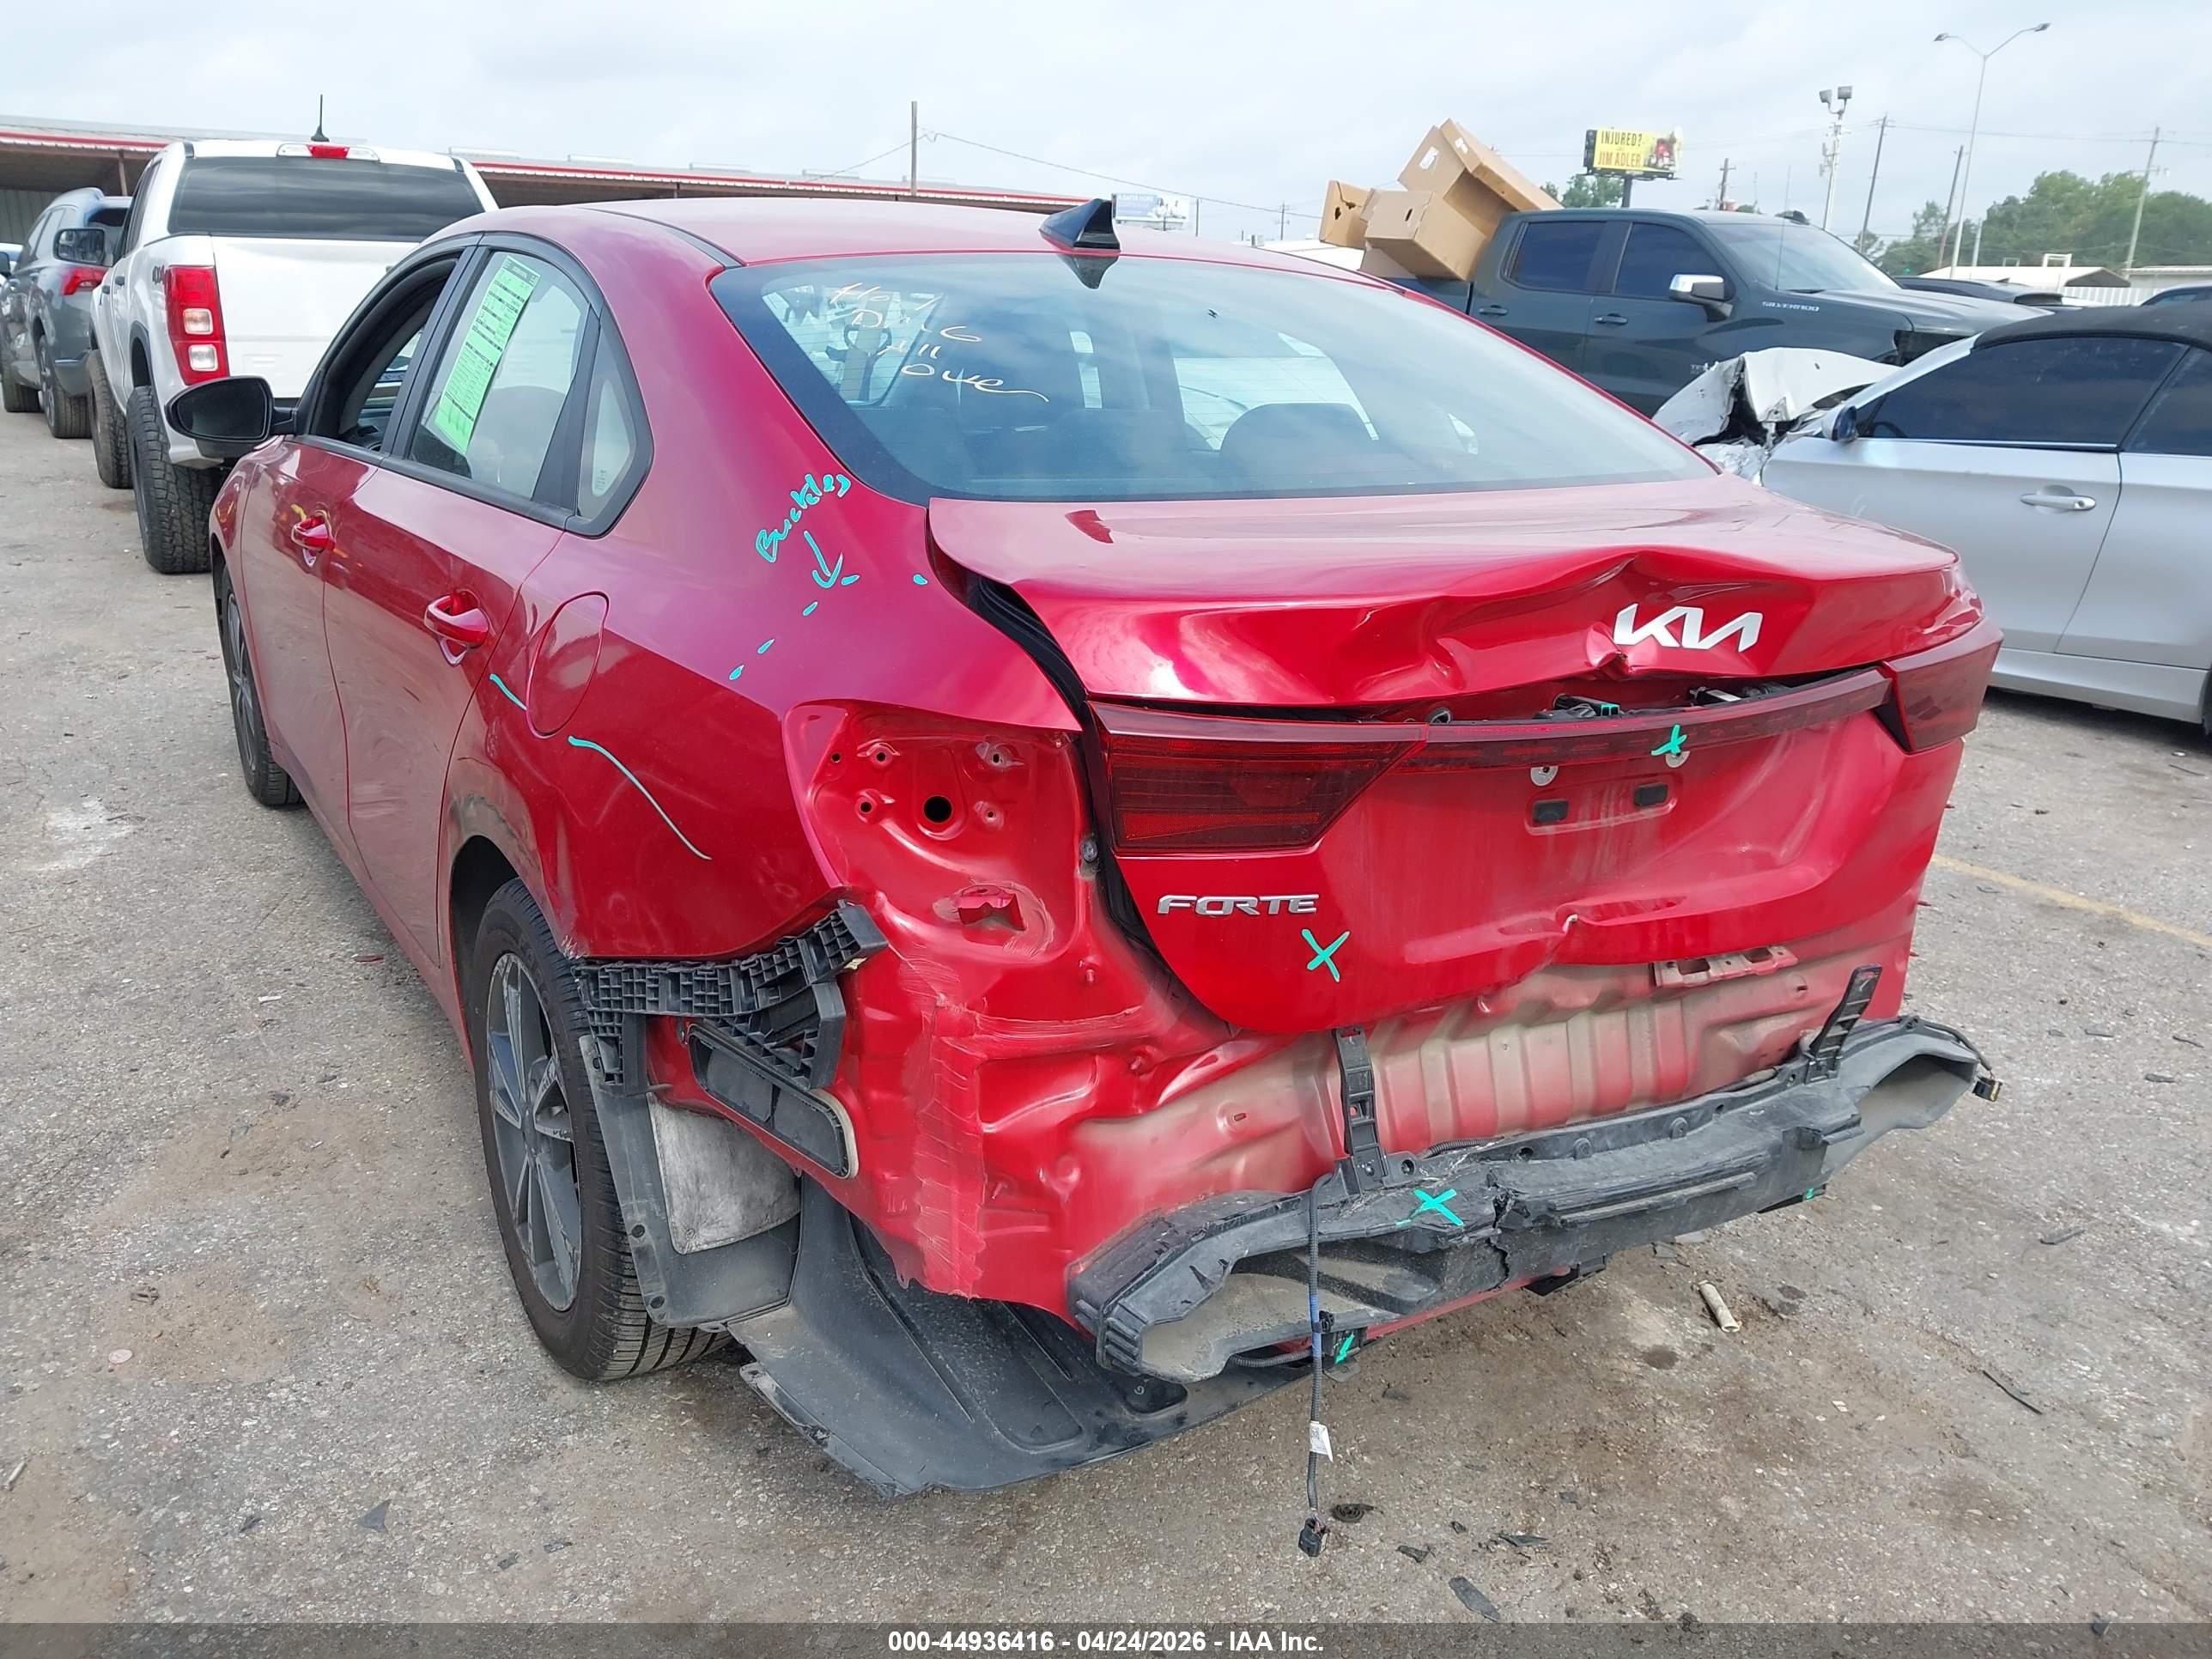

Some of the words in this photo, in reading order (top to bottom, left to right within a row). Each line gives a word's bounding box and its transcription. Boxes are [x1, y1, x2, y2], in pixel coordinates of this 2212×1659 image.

[1601, 130, 1643, 147] INJURED?
[1597, 151, 1613, 166] JIM
[1614, 152, 1641, 168] ADLER
[1613, 603, 1763, 653] KIA
[1157, 893, 1320, 915] FORTE
